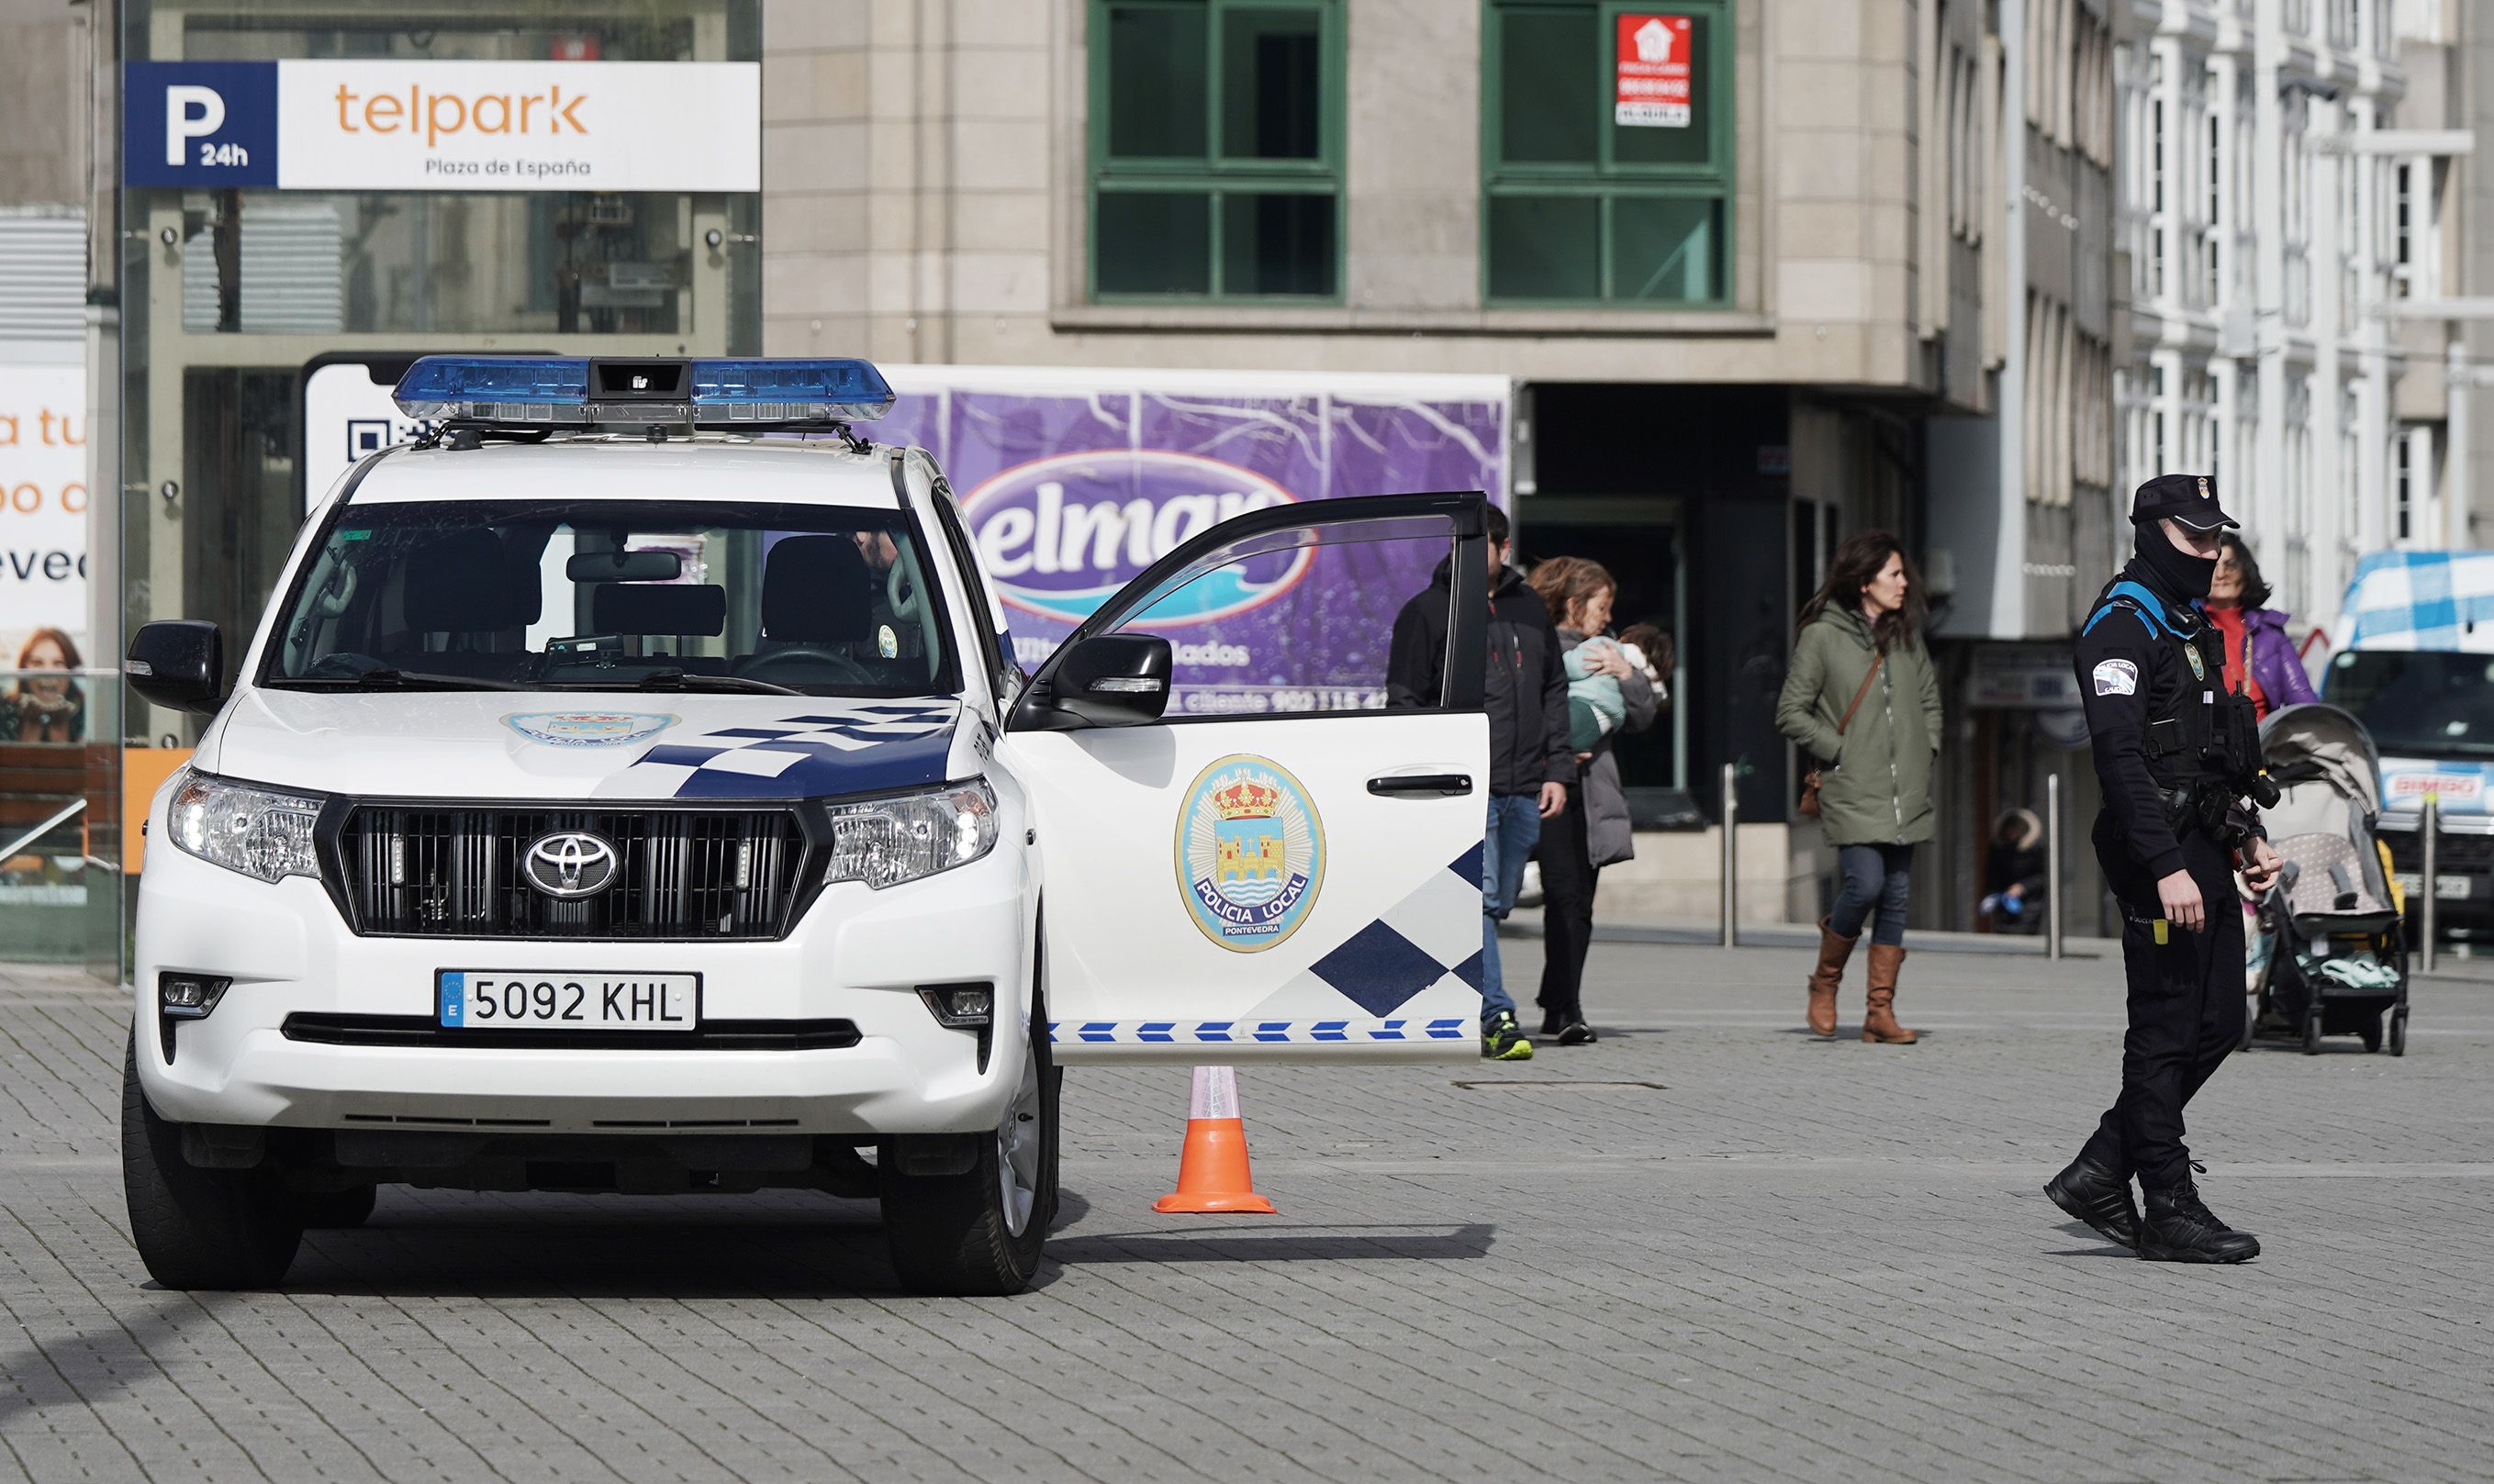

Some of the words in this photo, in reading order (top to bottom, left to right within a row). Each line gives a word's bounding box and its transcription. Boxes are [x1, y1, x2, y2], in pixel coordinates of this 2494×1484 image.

[166, 84, 226, 166] P
[334, 83, 589, 148] telpark
[200, 143, 249, 168] 24h
[425, 158, 479, 175] Plaza
[485, 158, 509, 175] de
[516, 158, 592, 178] España
[1196, 880, 1253, 923] POLICIA
[1262, 878, 1307, 919] LOCAL
[1224, 924, 1280, 935] PONTEVEDRA
[447, 1004, 458, 1016] E
[475, 980, 586, 1021] 5092
[602, 982, 684, 1021] KHL
